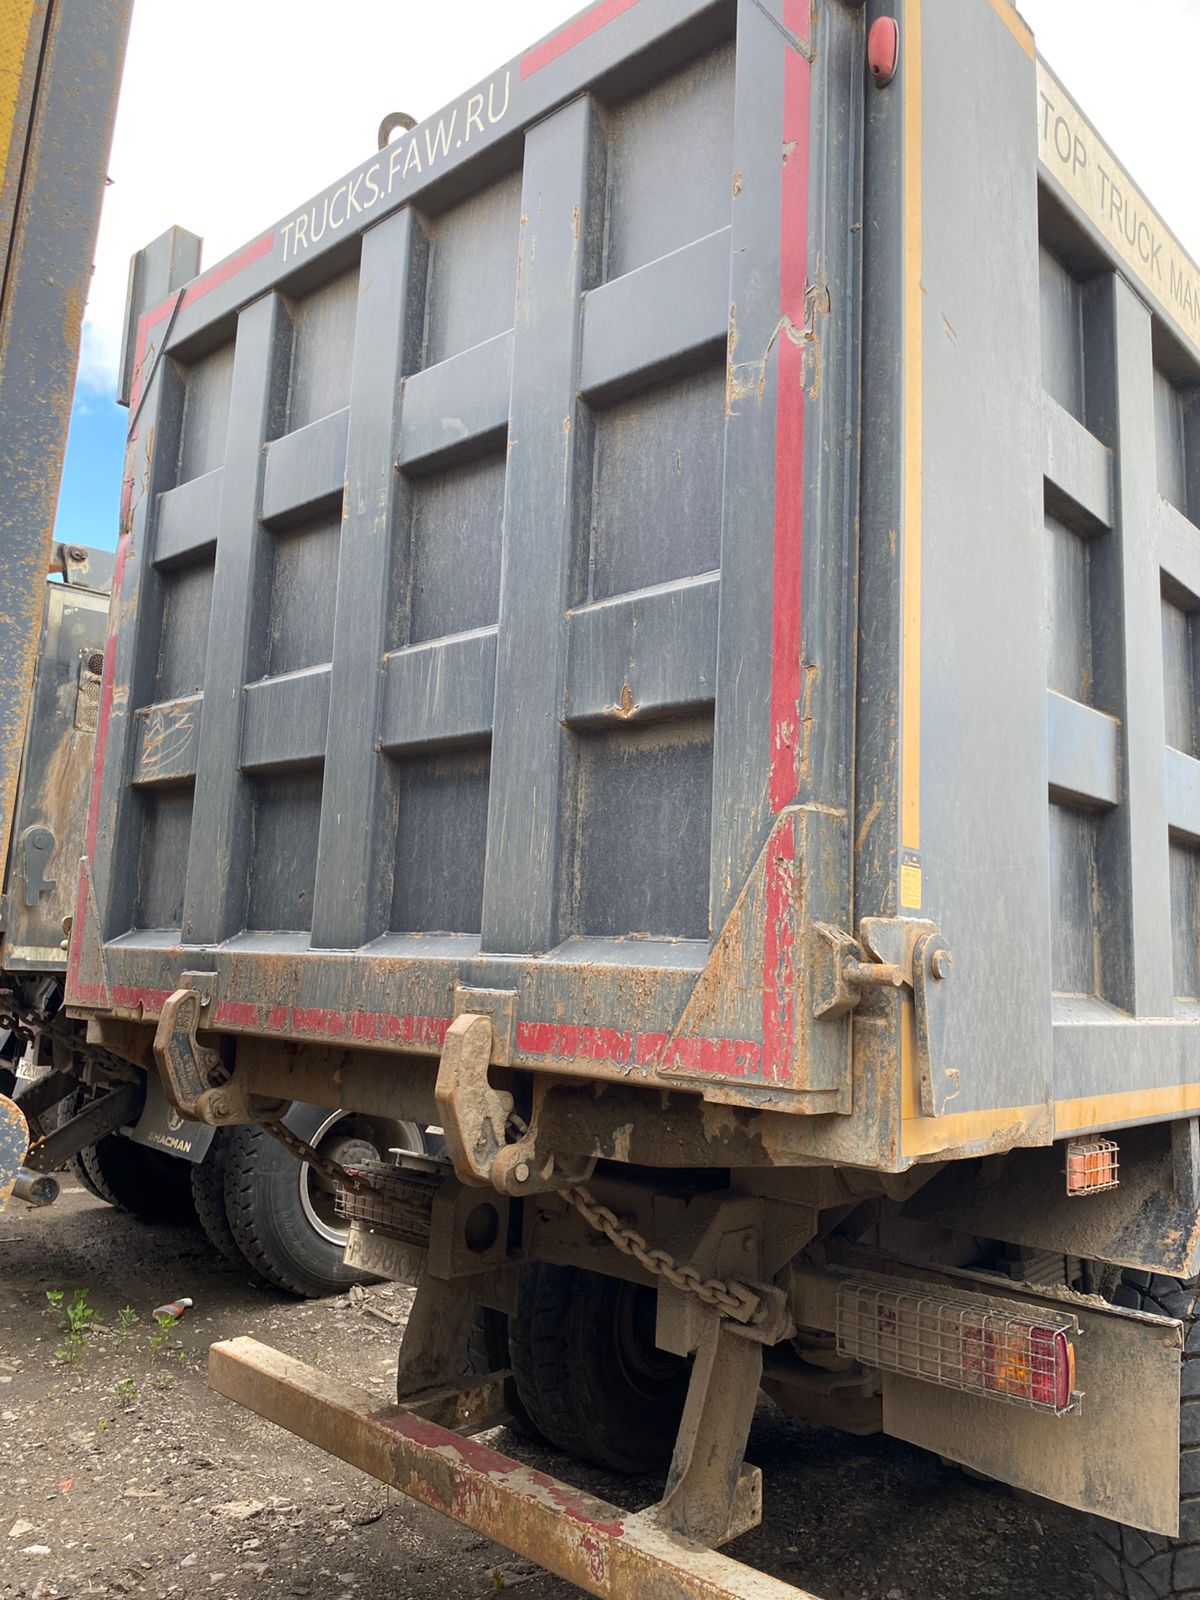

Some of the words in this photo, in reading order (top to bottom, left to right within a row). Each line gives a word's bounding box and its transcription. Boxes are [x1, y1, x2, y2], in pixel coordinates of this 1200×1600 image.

[280, 71, 511, 262] TRUCKS.FAW.RU
[1039, 90, 1087, 175] TOP
[1097, 163, 1163, 281] TRUCK
[148, 1131, 192, 1153] SHACMAN
